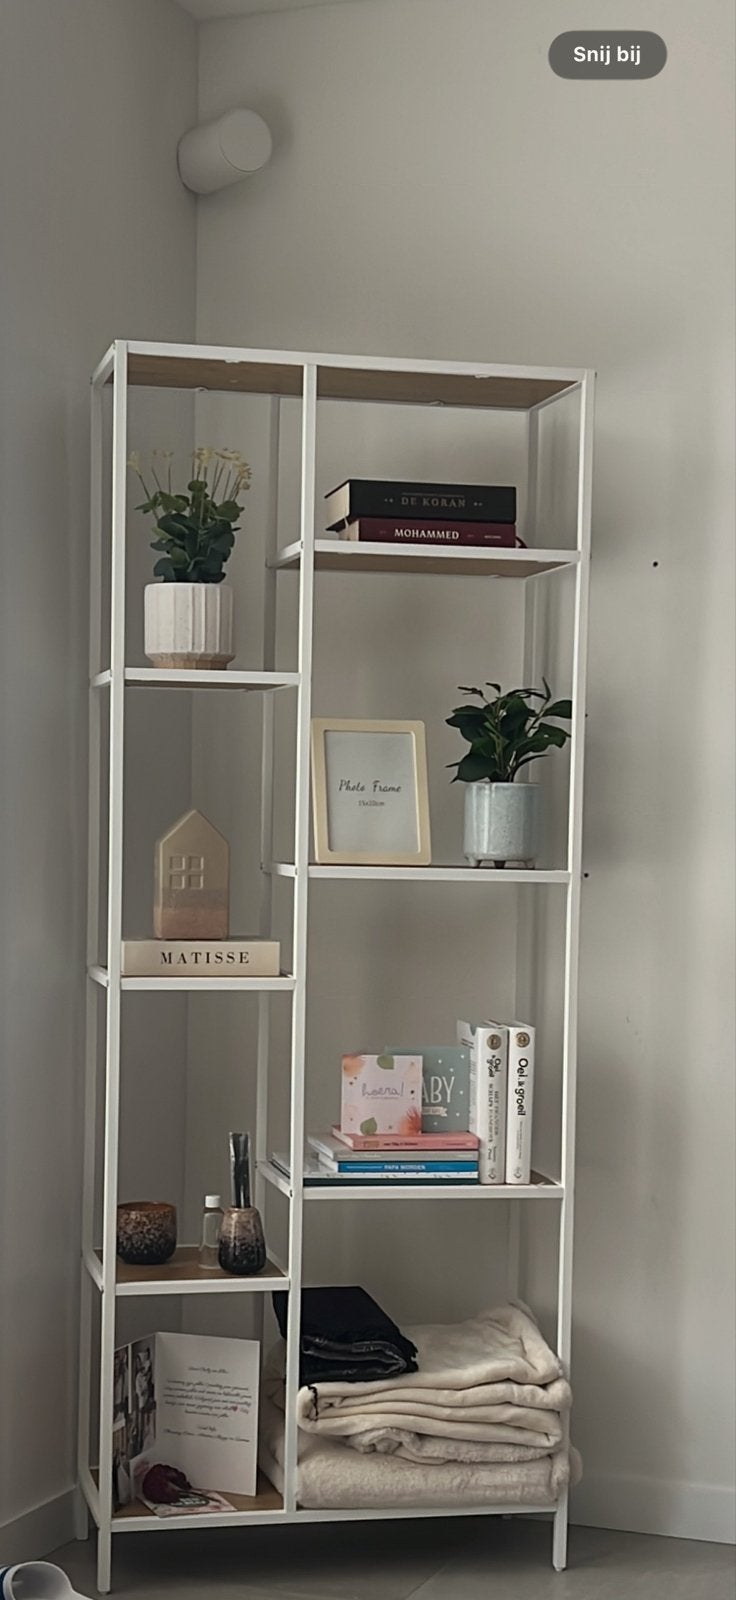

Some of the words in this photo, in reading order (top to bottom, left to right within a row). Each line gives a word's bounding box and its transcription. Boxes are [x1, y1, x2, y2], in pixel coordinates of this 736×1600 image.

[401, 496, 418, 506] DE
[422, 498, 466, 509] KORAN
[394, 528, 460, 540] MOHAMMED
[338, 779, 366, 792] Photo
[373, 780, 402, 793] Frame
[160, 951, 250, 965] MATISSE
[361, 1081, 405, 1097] hoera!
[421, 1076, 456, 1104] ABY
